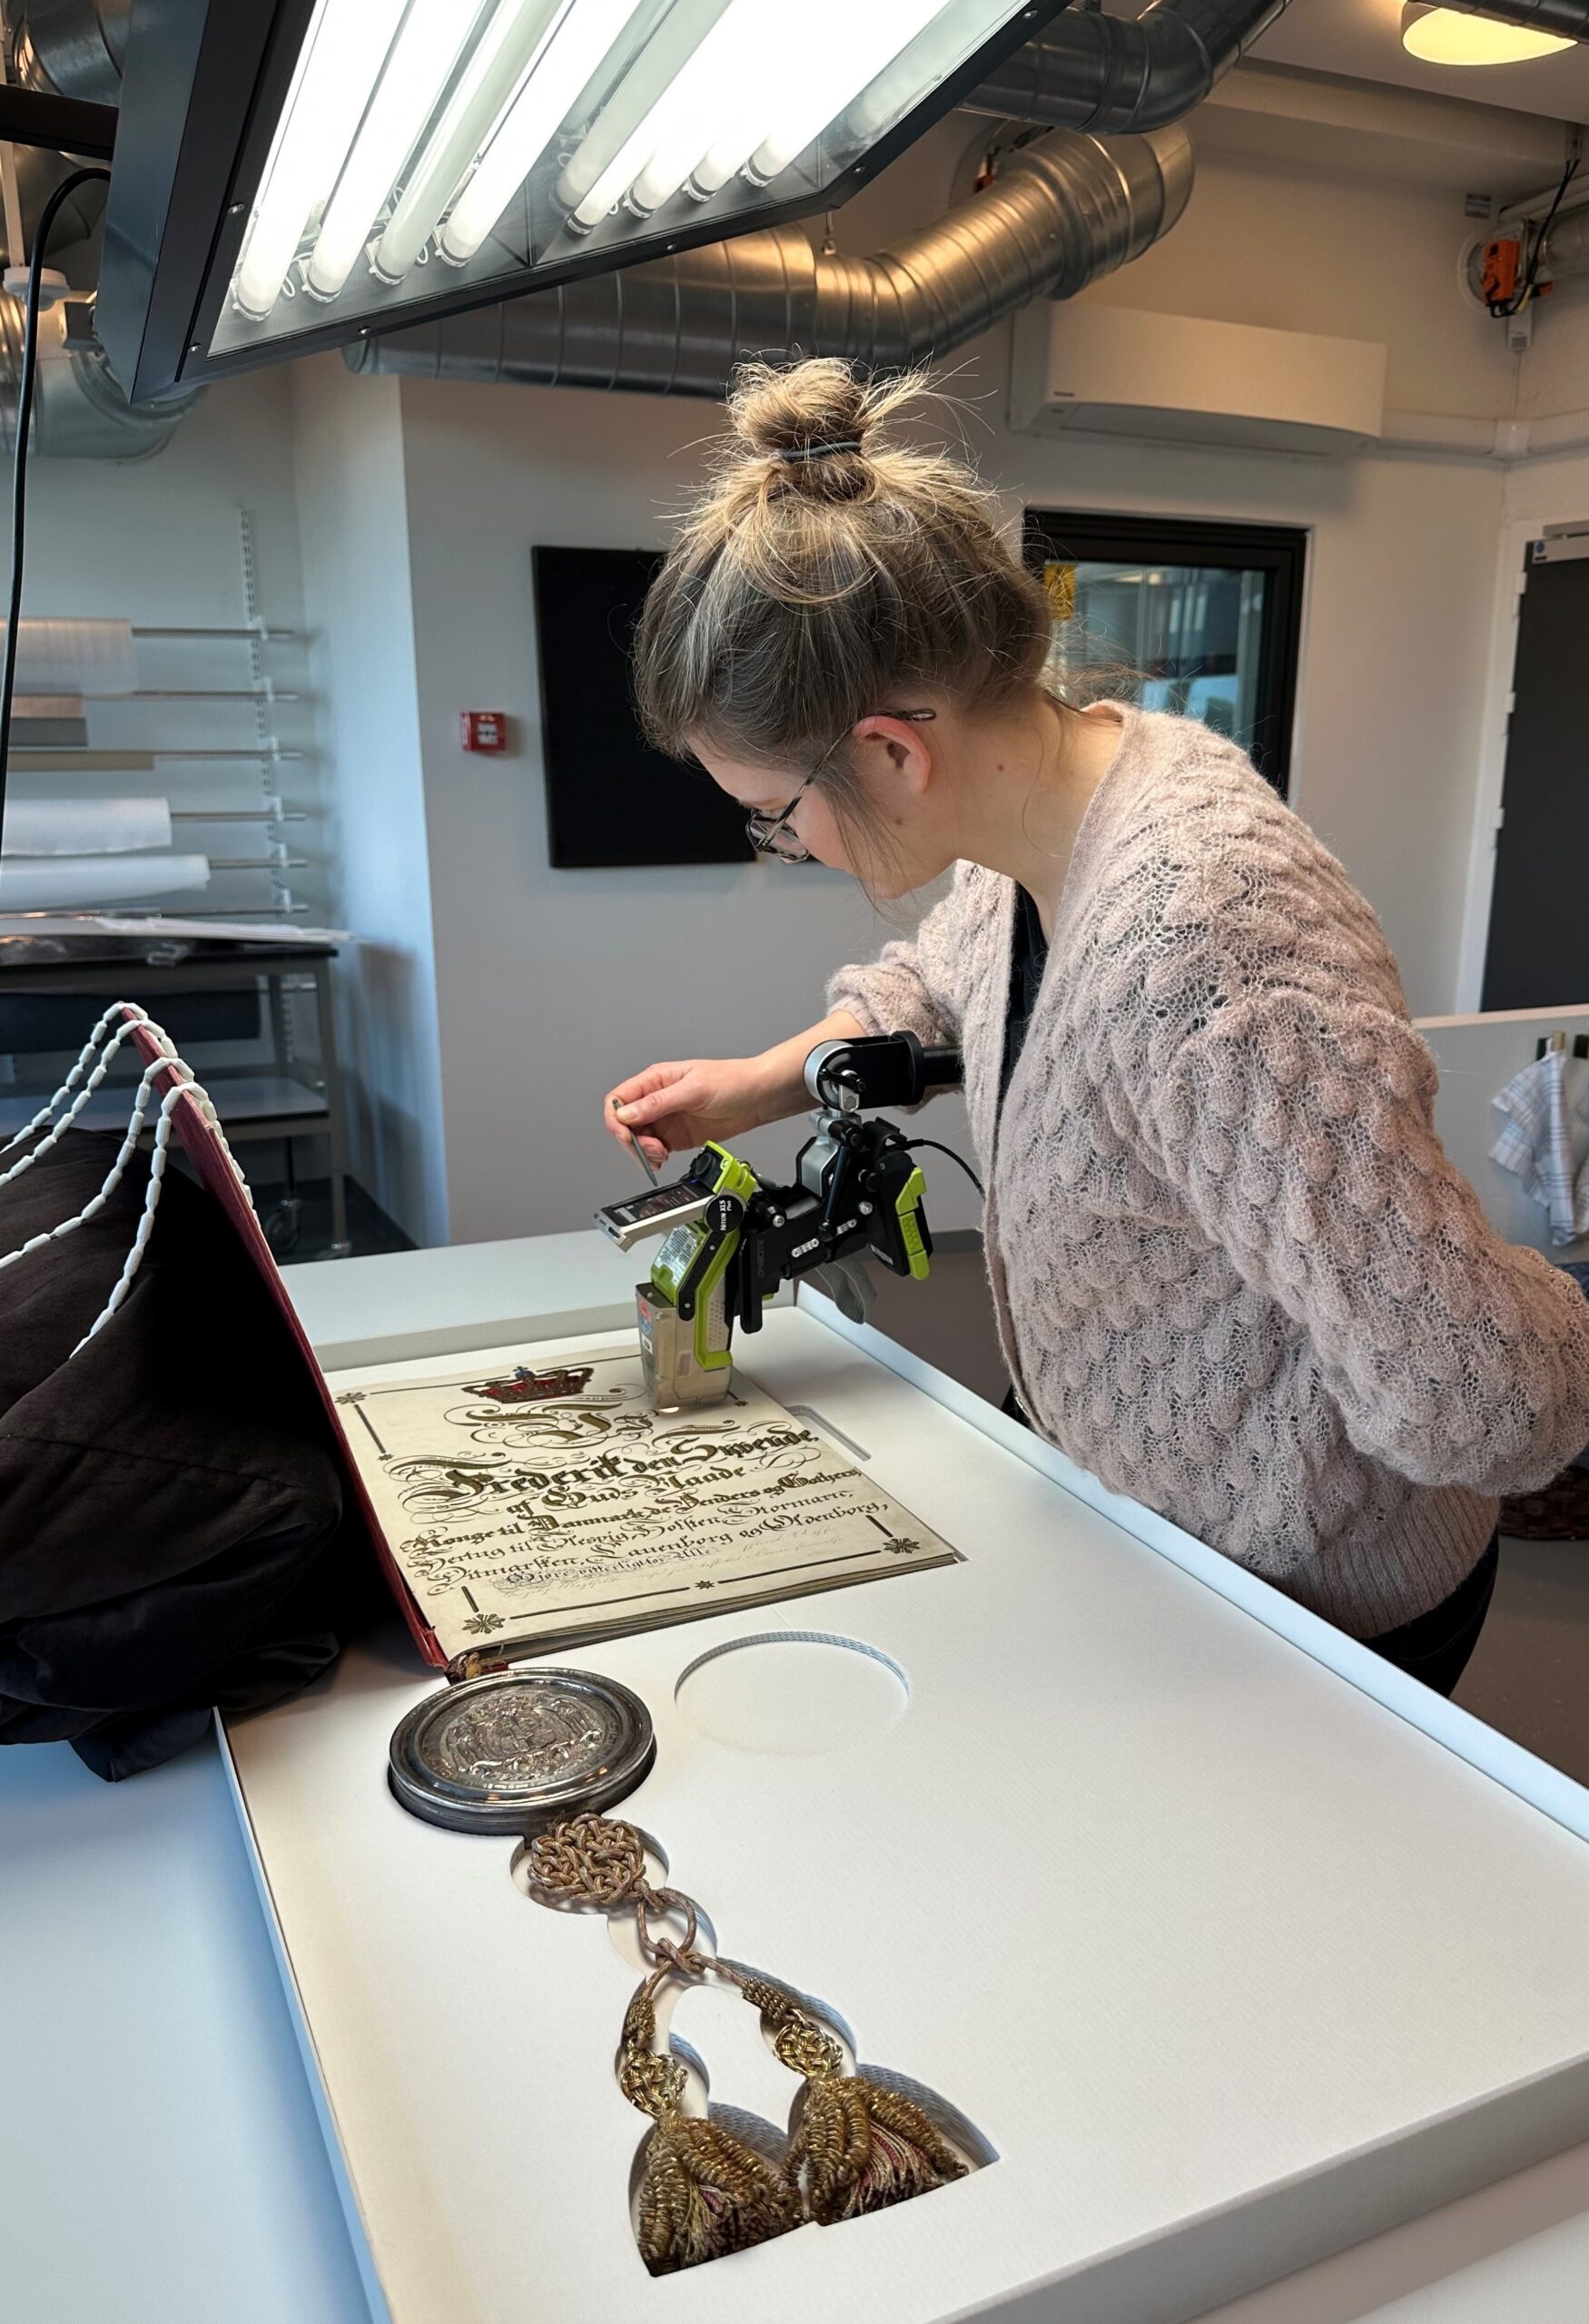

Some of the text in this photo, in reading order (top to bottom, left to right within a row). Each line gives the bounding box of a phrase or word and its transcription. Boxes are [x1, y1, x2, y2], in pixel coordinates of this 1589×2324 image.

[719, 1212, 727, 1231] NITON
[392, 1452, 629, 1506] Frederik
[623, 1453, 683, 1474] den
[498, 1521, 525, 1537] til
[763, 1482, 785, 1498] og
[506, 1496, 536, 1517] af
[739, 1526, 763, 1539] og
[510, 1540, 533, 1553] til
